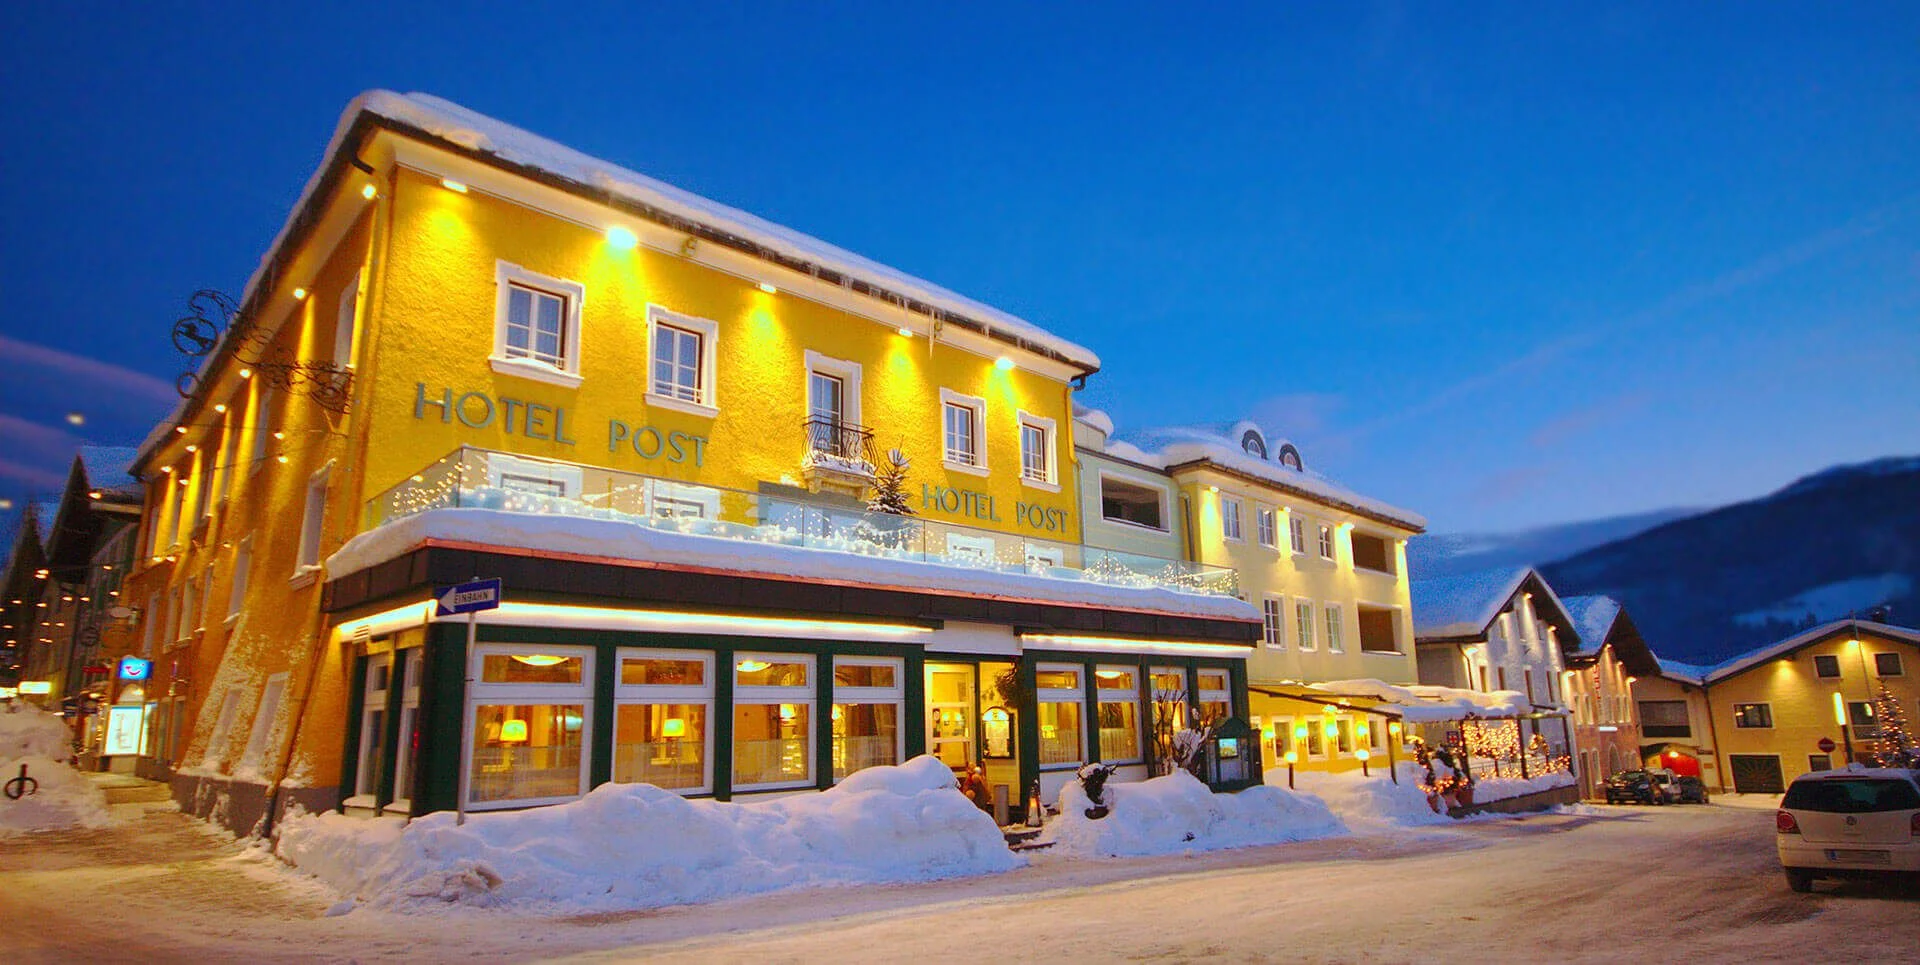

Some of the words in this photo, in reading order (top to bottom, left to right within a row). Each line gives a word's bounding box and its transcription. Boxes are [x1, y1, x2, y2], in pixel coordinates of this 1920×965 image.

[415, 382, 576, 446] HOTEL
[608, 419, 709, 467] POST
[922, 483, 1002, 523] HOTEL
[1016, 501, 1069, 533] POST
[454, 590, 489, 605] EINBAHN
